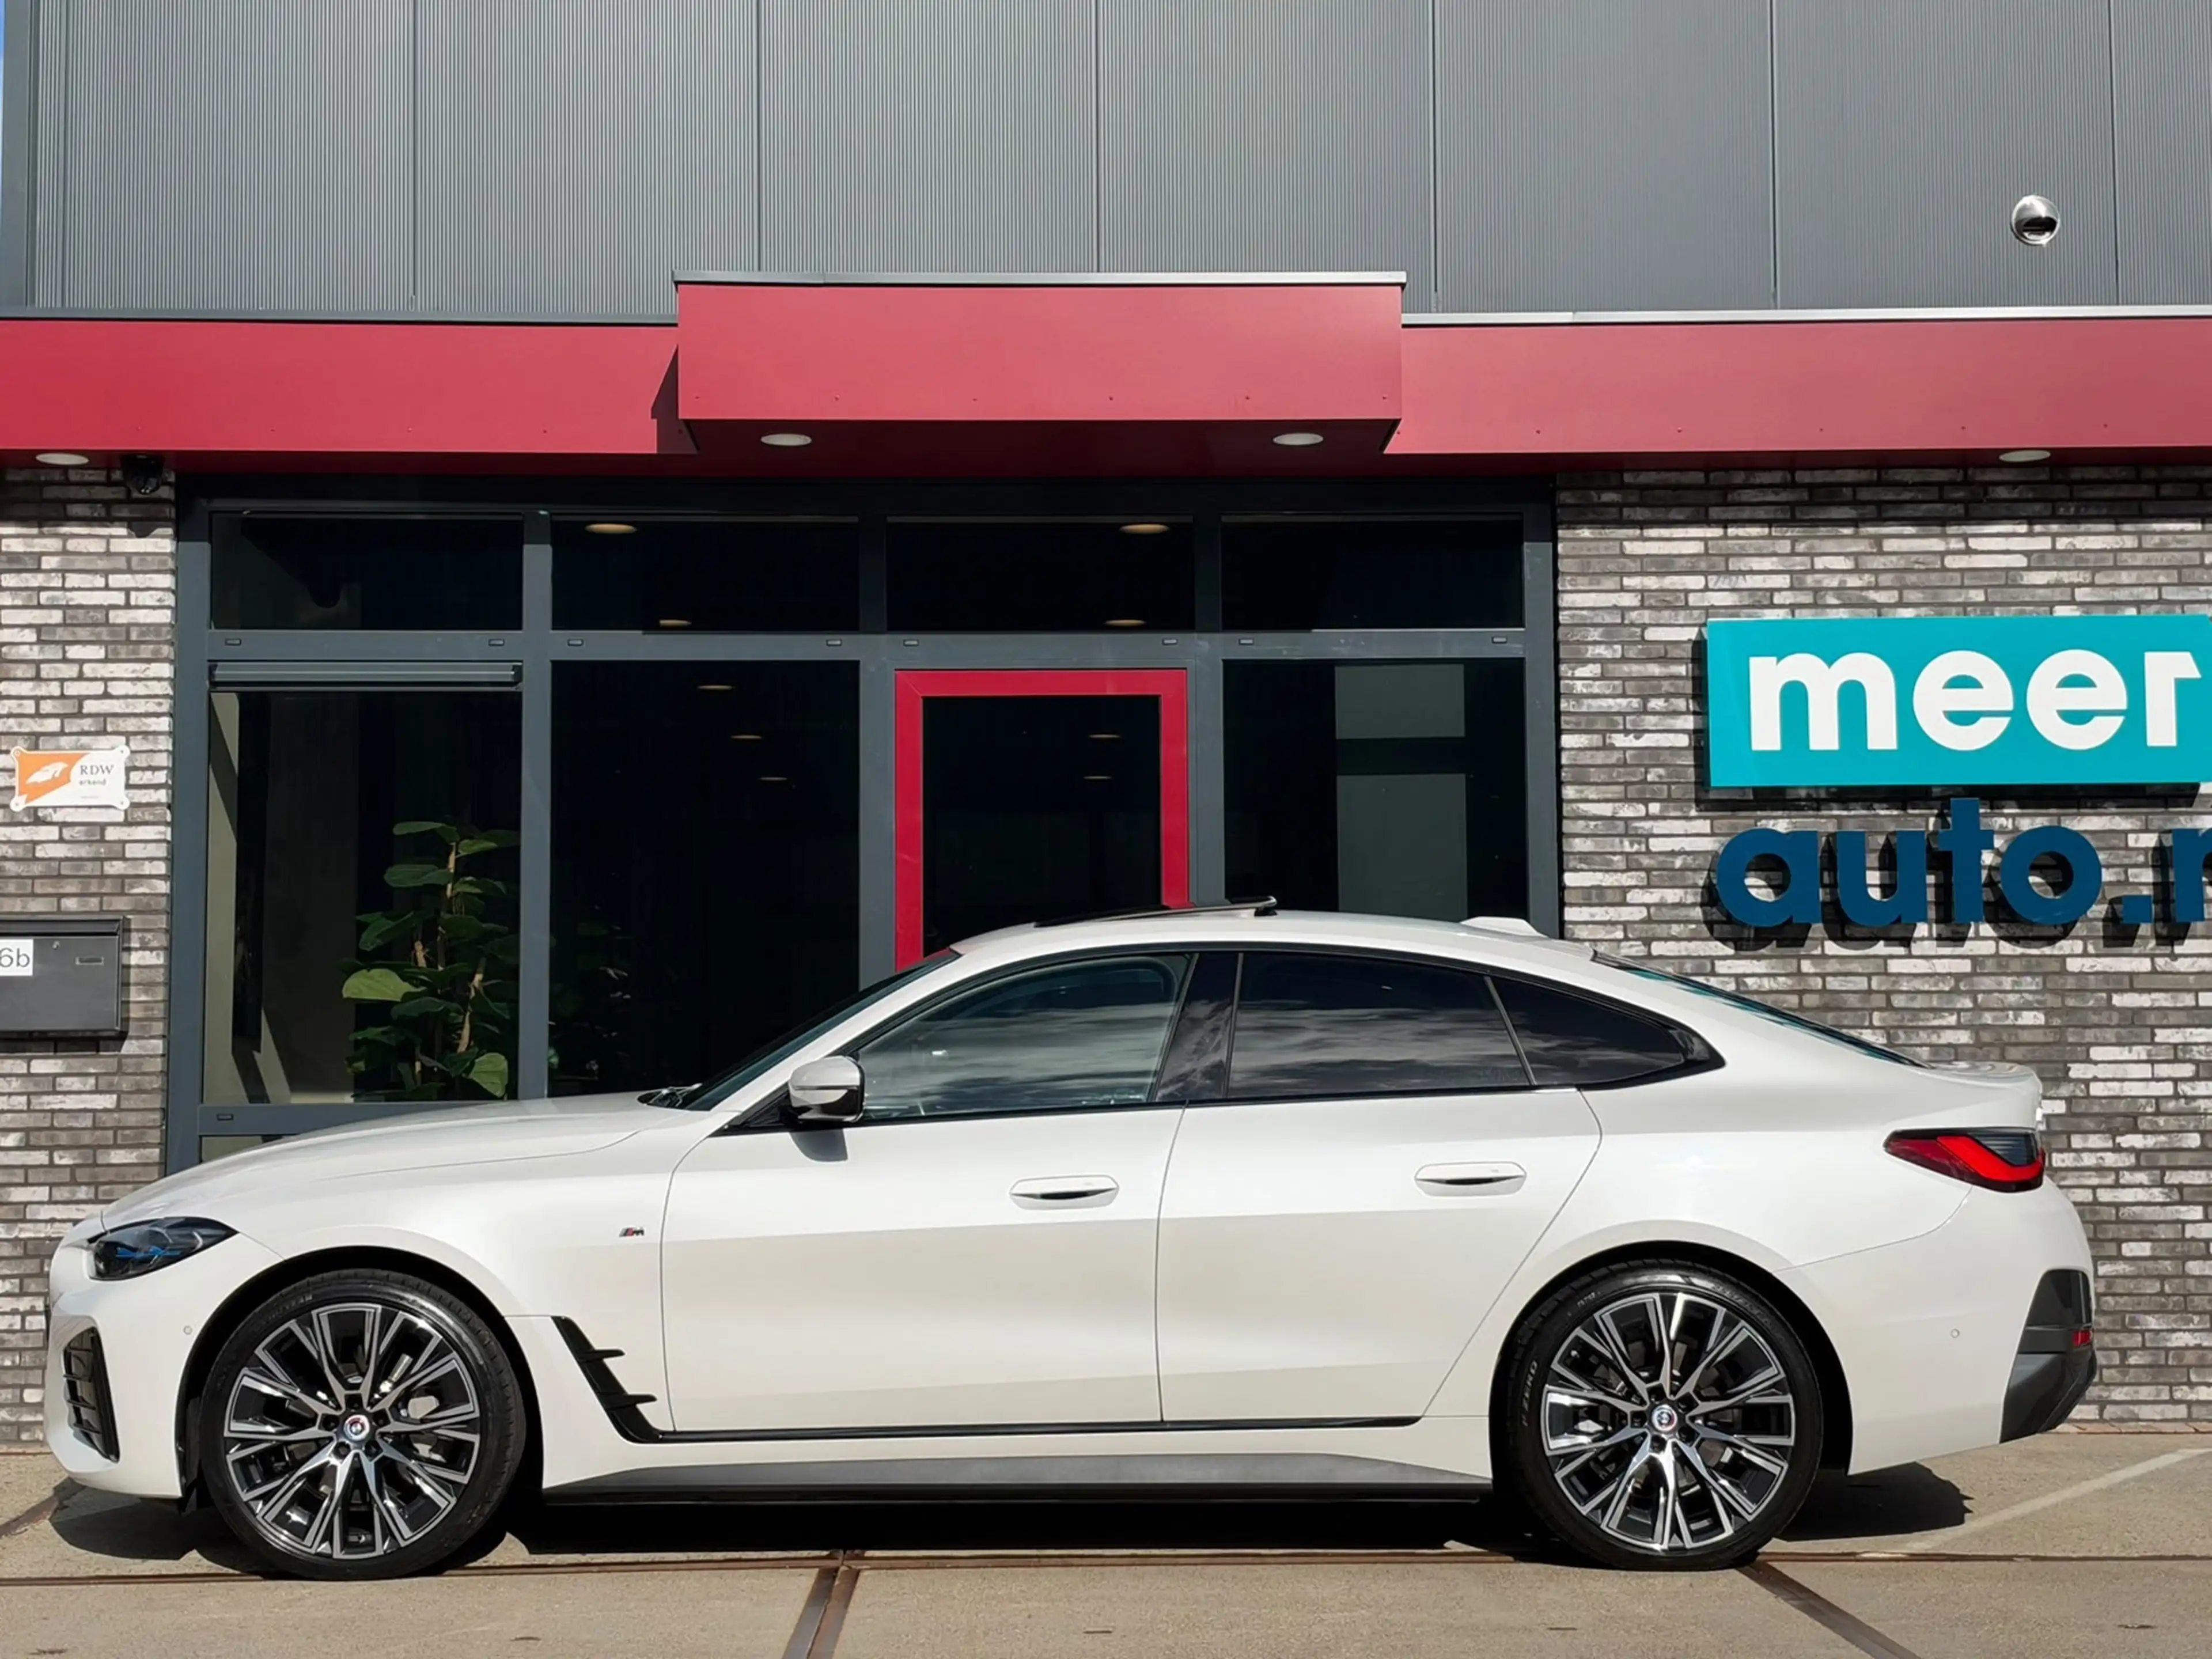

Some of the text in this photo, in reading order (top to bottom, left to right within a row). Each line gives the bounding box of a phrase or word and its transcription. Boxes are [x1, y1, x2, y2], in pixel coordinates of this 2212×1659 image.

[1749, 650, 2202, 751] meer
[80, 764, 114, 775] RDW
[0, 947, 30, 968] 6b
